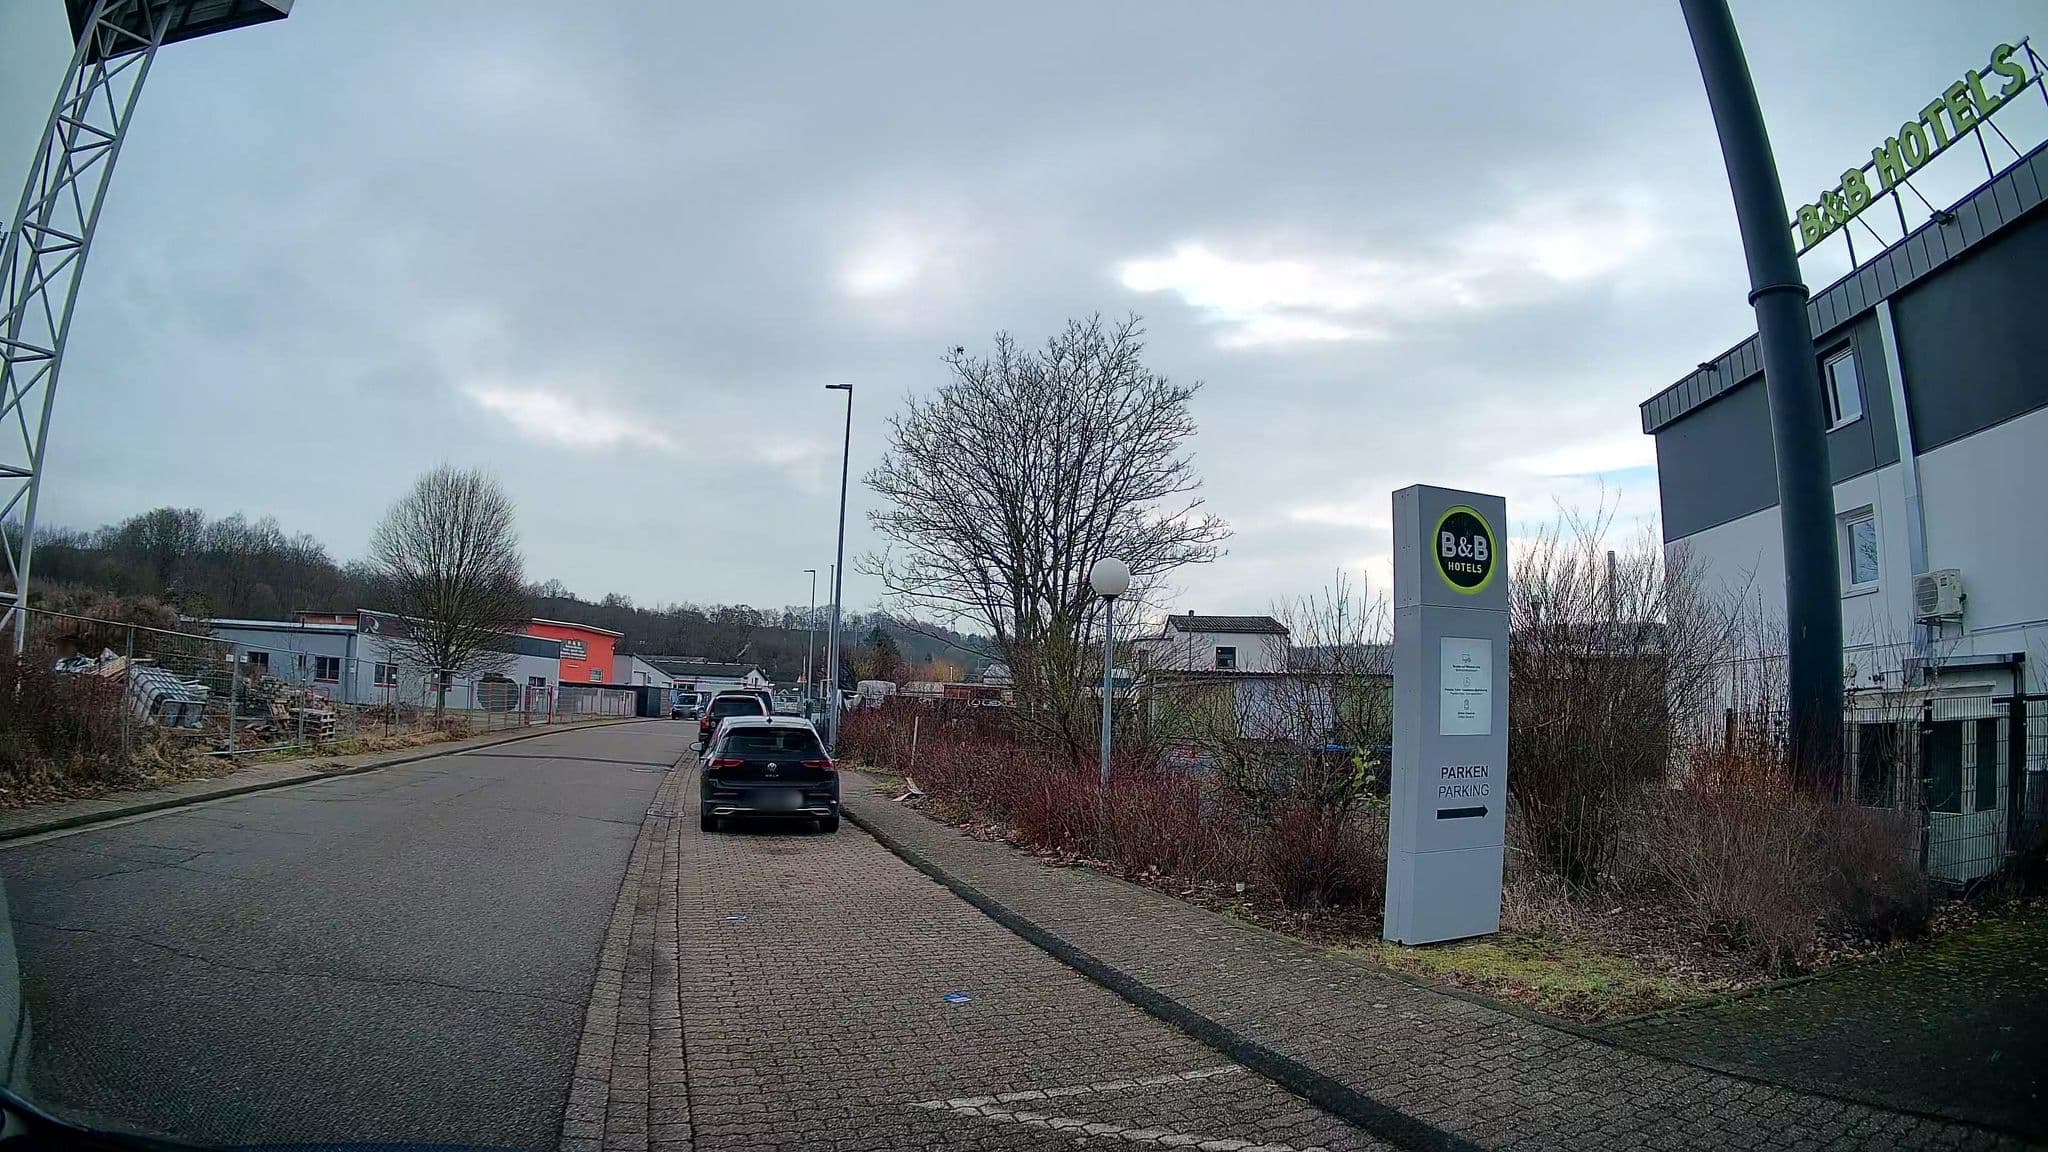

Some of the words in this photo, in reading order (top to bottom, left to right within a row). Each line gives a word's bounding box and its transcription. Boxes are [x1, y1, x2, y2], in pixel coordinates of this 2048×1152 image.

[1796, 168, 1871, 247] B&B
[1872, 43, 2026, 188] HOTELS
[1441, 531, 1488, 561] B&B
[1448, 561, 1483, 574] HOTELS
[1441, 765, 1489, 779] PARKEN
[1438, 783, 1490, 799] PARKING
